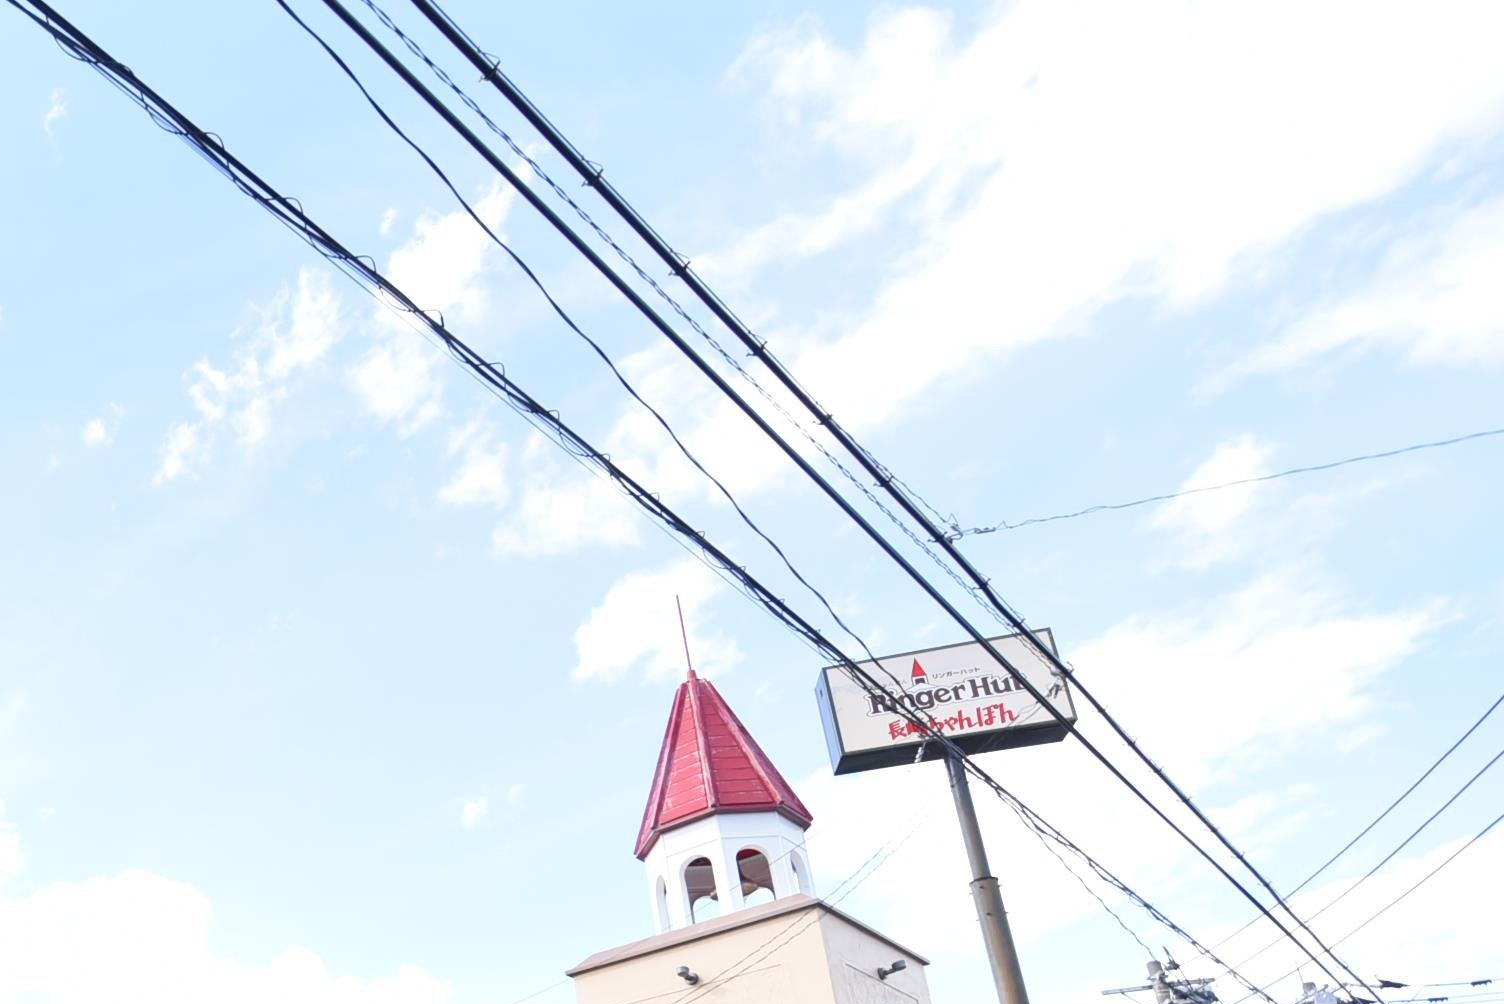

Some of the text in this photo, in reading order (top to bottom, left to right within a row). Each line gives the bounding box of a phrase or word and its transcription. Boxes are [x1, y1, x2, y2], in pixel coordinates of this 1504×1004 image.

[932, 667, 981, 679] リンガーハット
[868, 684, 966, 714] Ringer
